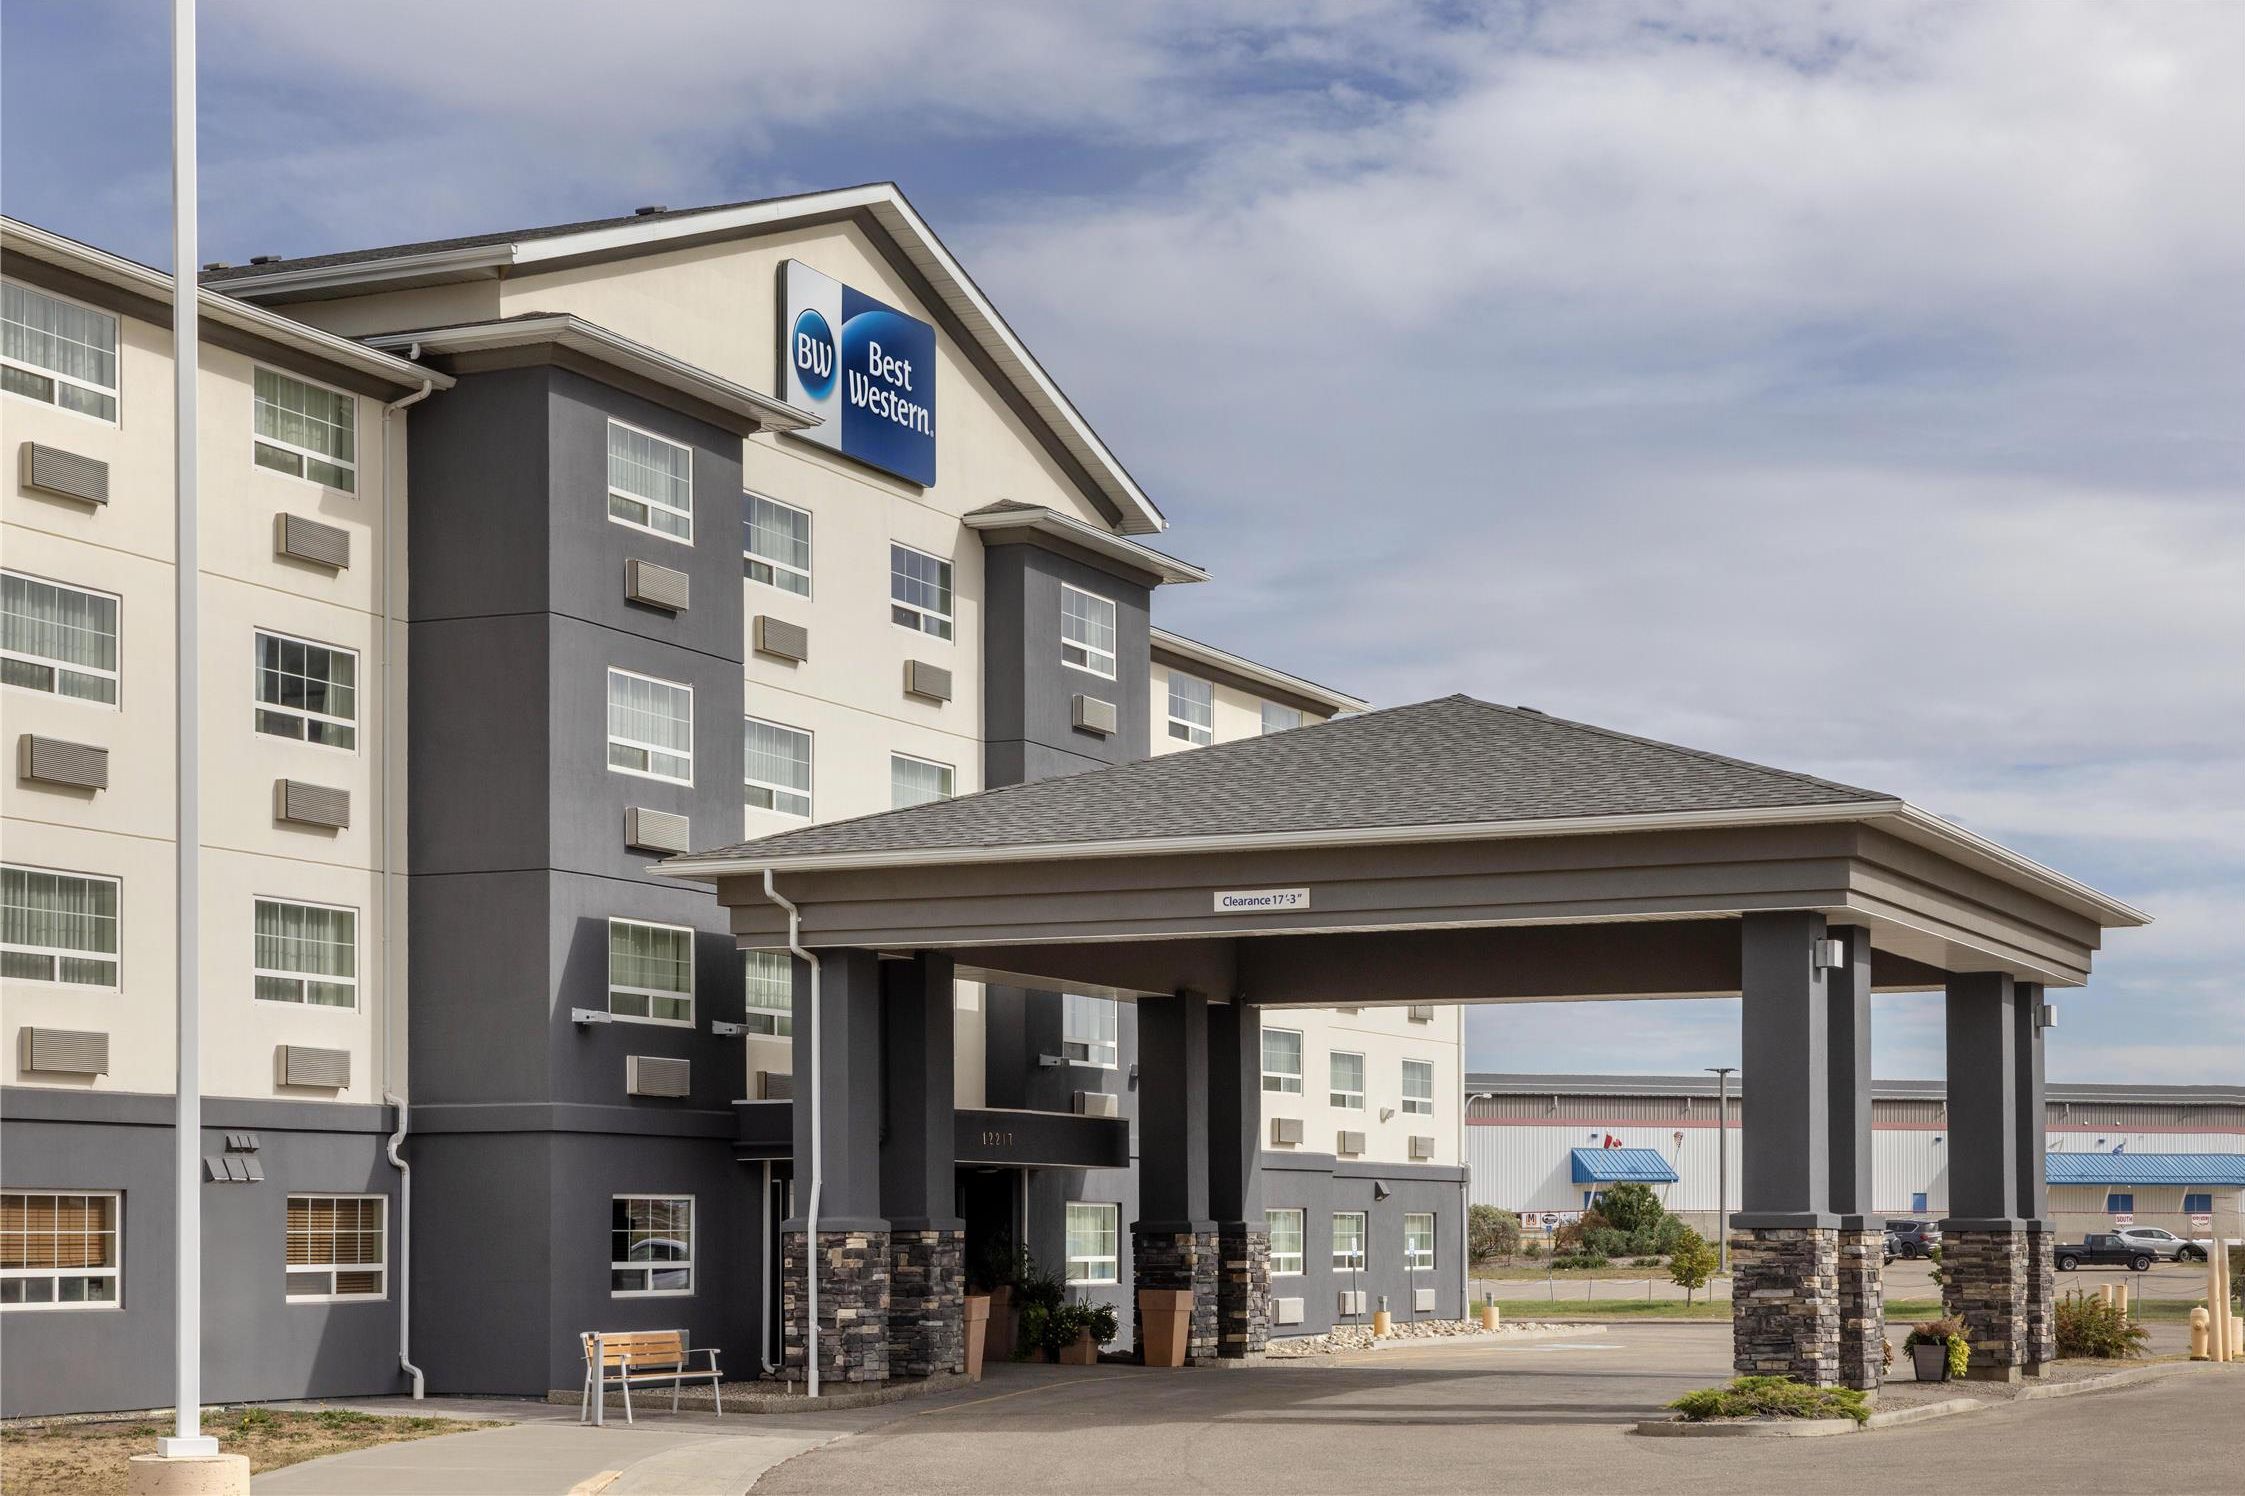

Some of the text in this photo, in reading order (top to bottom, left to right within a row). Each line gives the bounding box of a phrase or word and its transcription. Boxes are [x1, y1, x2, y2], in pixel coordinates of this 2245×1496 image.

[798, 332, 833, 379] BW
[869, 341, 913, 392] Best
[1223, 896, 1271, 907] Clearance
[983, 1131, 1013, 1146] 12217
